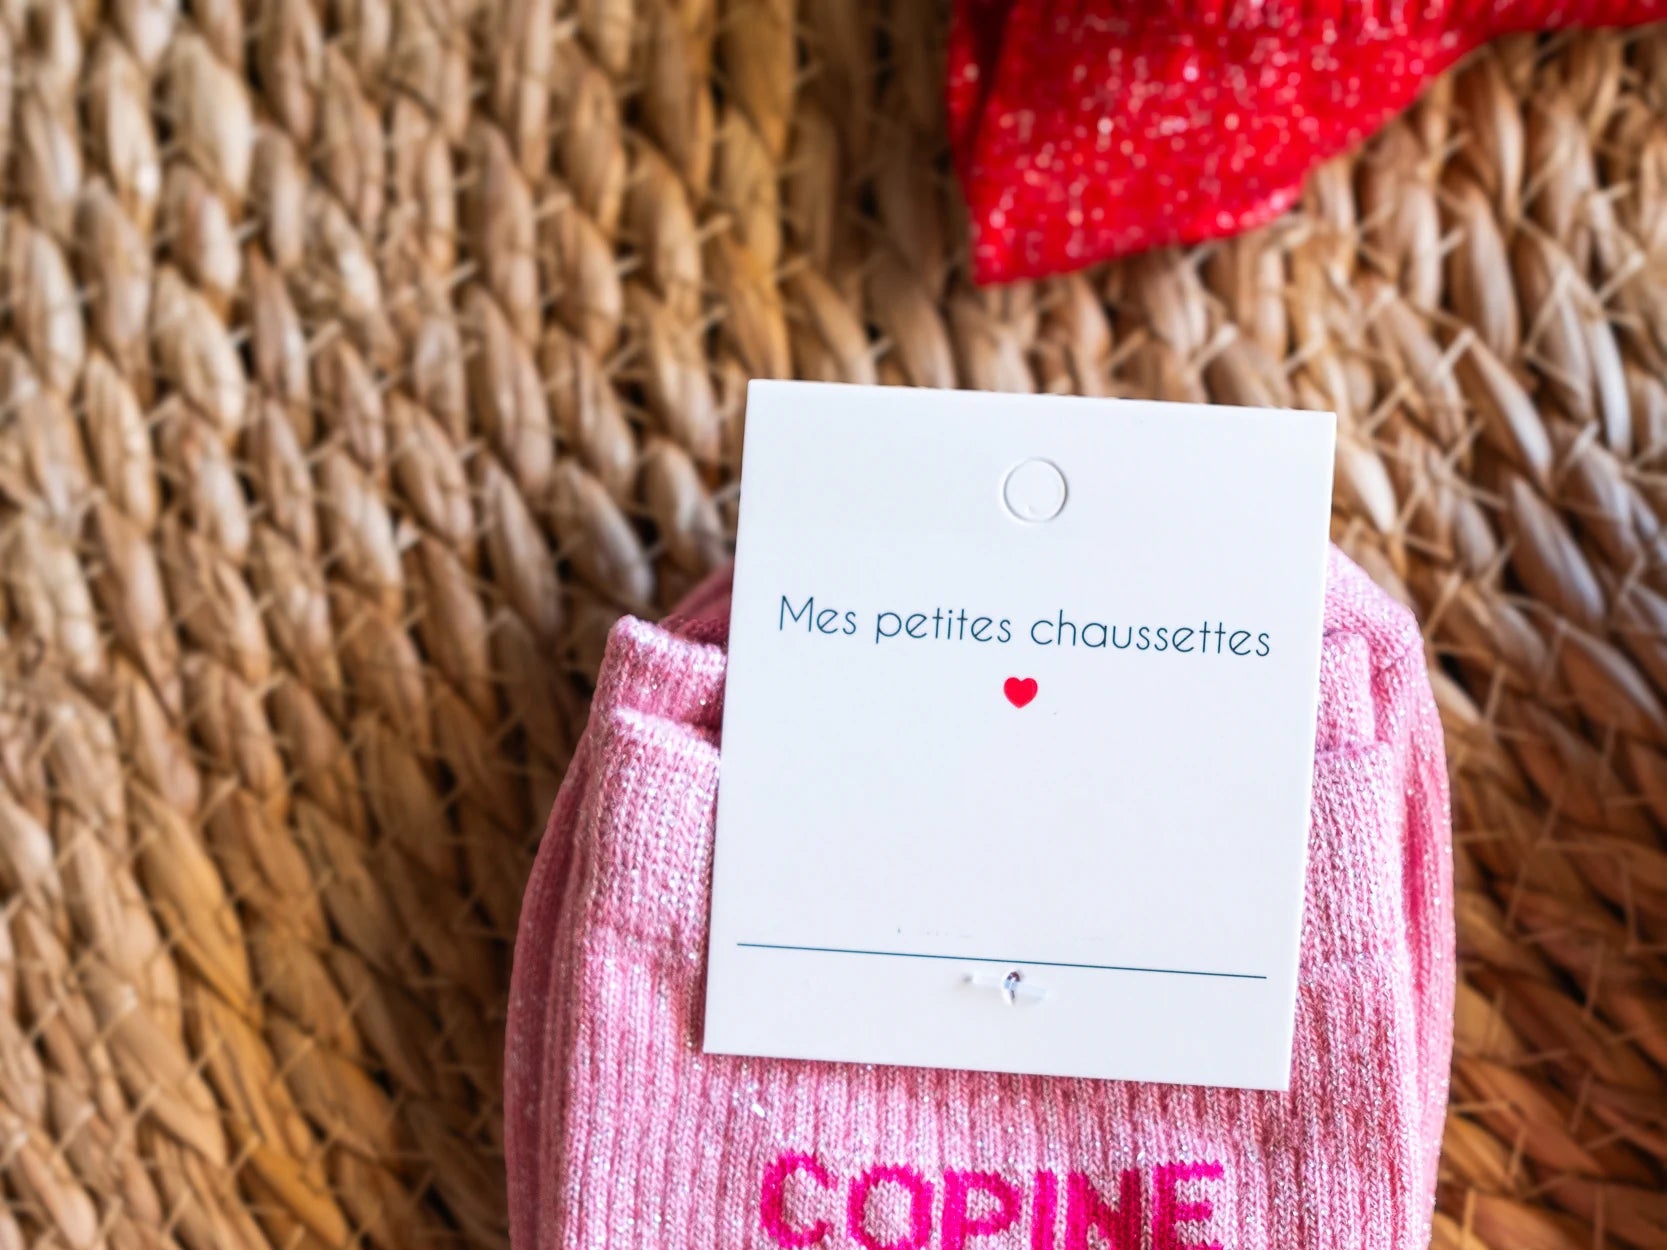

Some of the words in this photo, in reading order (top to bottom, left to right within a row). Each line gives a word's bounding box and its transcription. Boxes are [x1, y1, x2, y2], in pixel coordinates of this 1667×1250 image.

[779, 595, 857, 635] Mes
[875, 607, 1012, 645] petites
[1030, 609, 1271, 657] chaussettes
